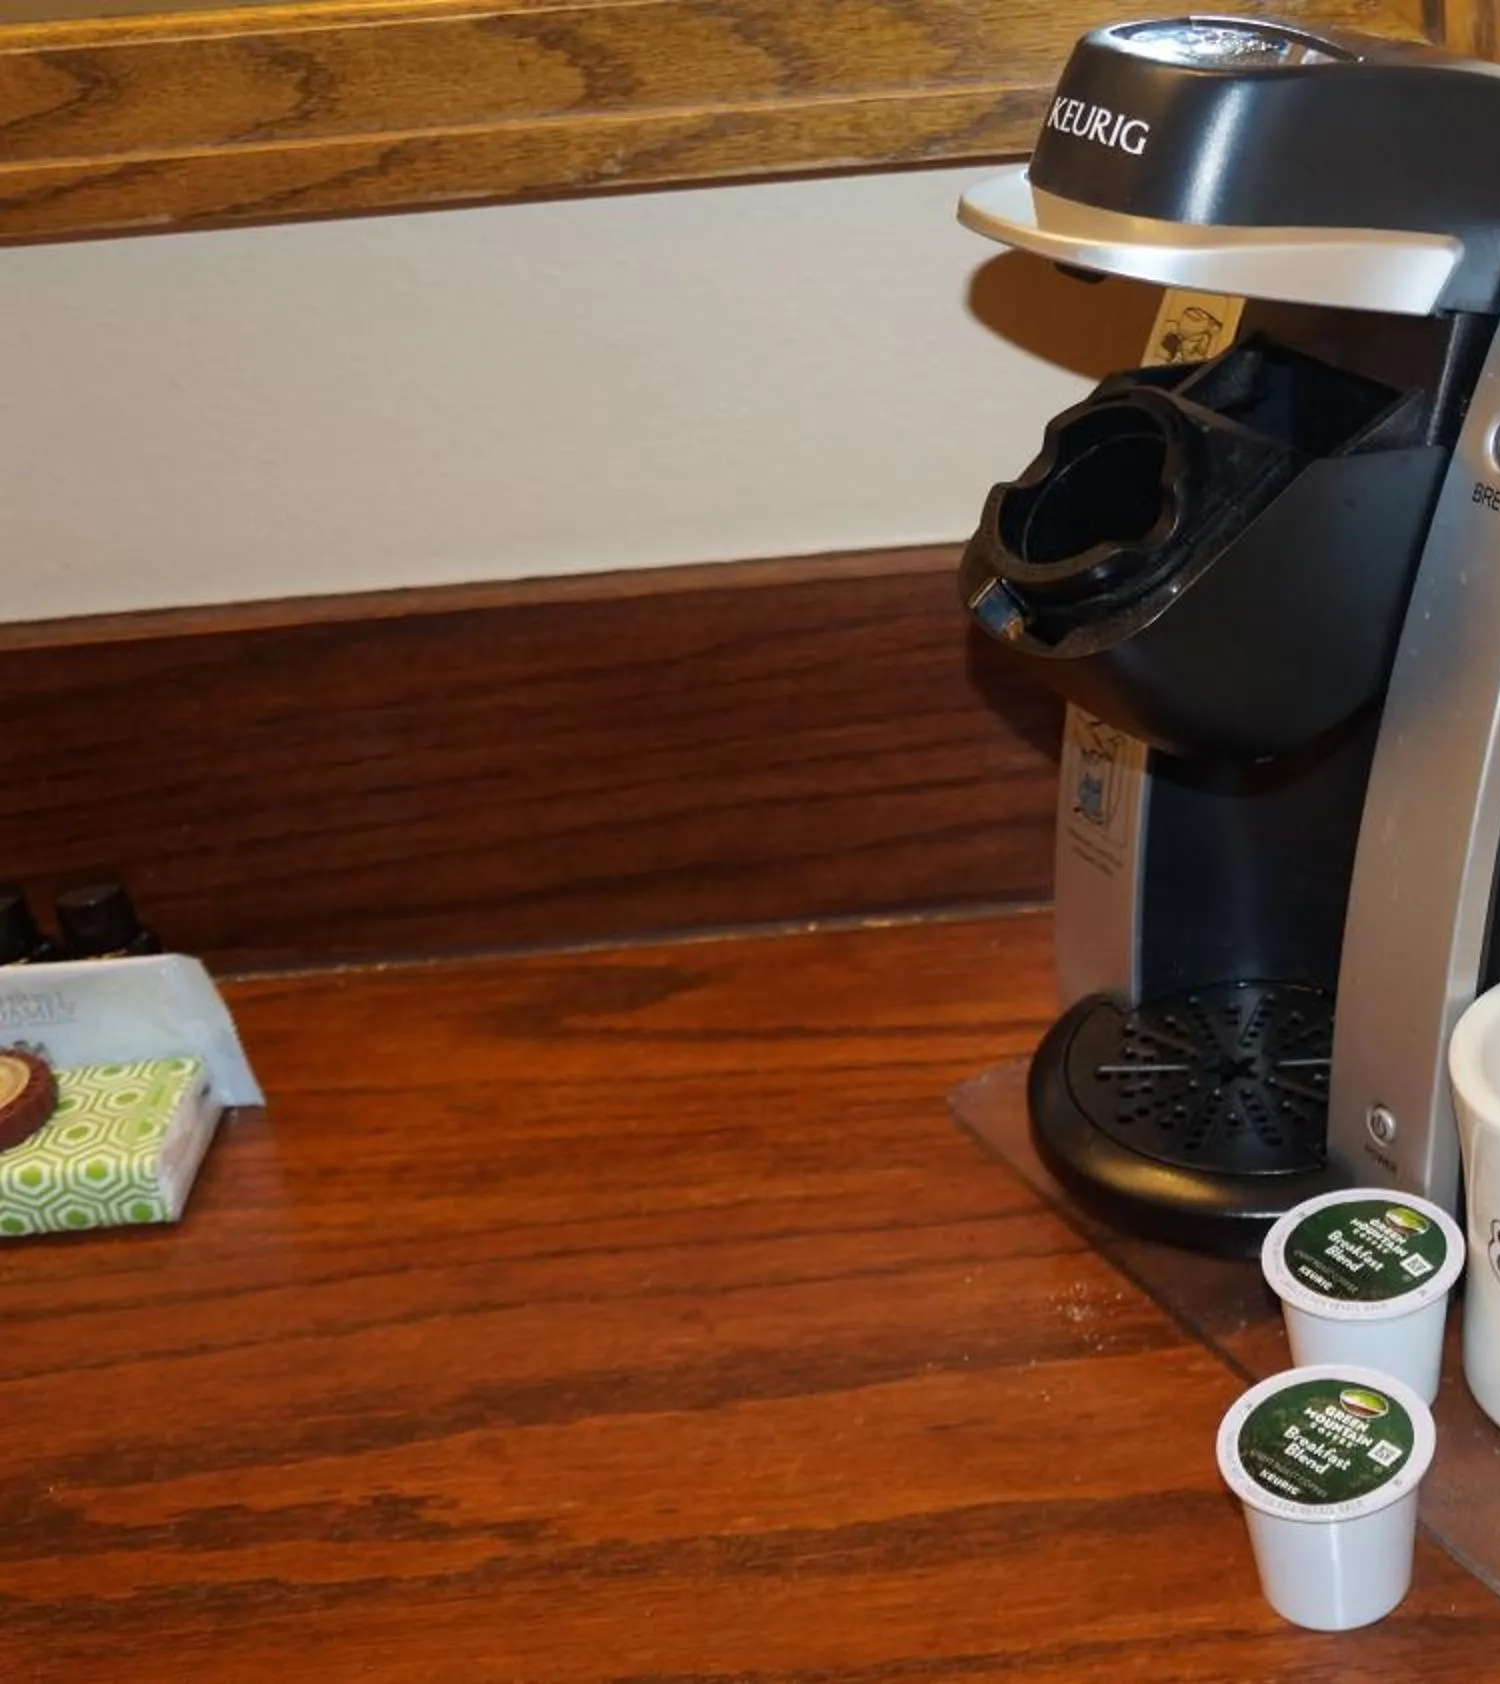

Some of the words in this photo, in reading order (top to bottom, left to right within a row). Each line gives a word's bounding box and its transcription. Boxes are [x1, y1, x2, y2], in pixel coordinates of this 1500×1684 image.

[1047, 97, 1150, 155] KEURIG
[1324, 1245, 1365, 1273] Blend
[1328, 1230, 1385, 1272] Breakfast
[1303, 1406, 1373, 1448] MOUNTAIN
[1325, 1405, 1369, 1432] GREEN
[1283, 1425, 1351, 1471] Breakfast
[1284, 1443, 1330, 1475] Blend
[1259, 1469, 1300, 1495] KEURIG
